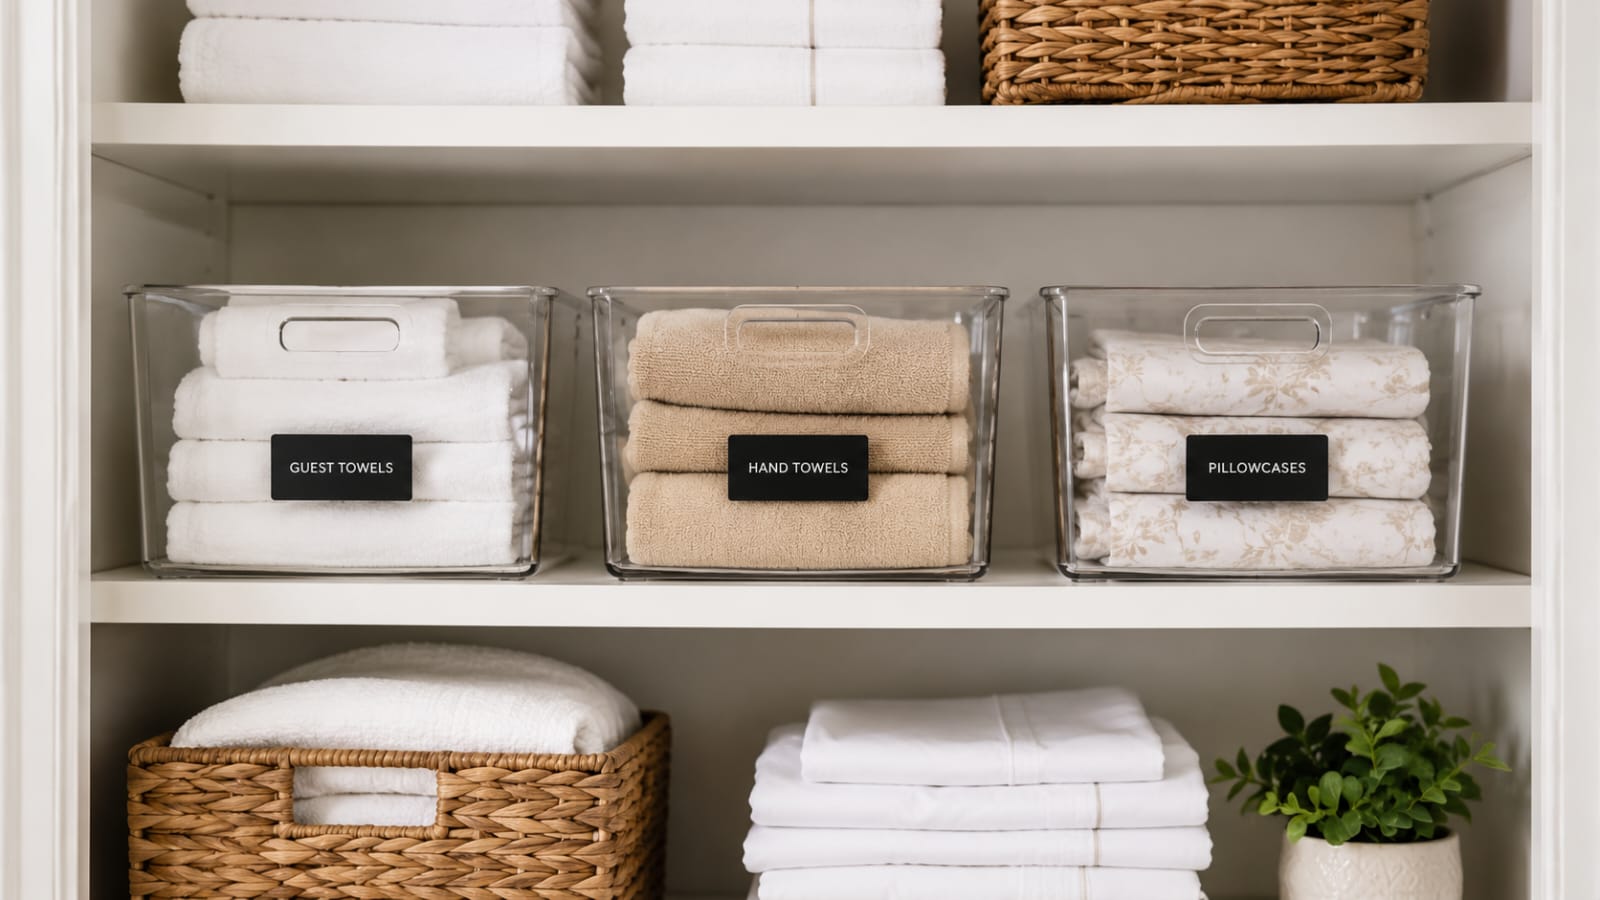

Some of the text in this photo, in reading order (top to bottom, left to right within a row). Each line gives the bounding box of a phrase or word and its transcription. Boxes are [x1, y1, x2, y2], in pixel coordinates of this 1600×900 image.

[289, 461, 394, 474] GUEST TOWELS
[748, 461, 849, 474] HAND TOWELS
[1208, 461, 1306, 474] PILLOWCASES
